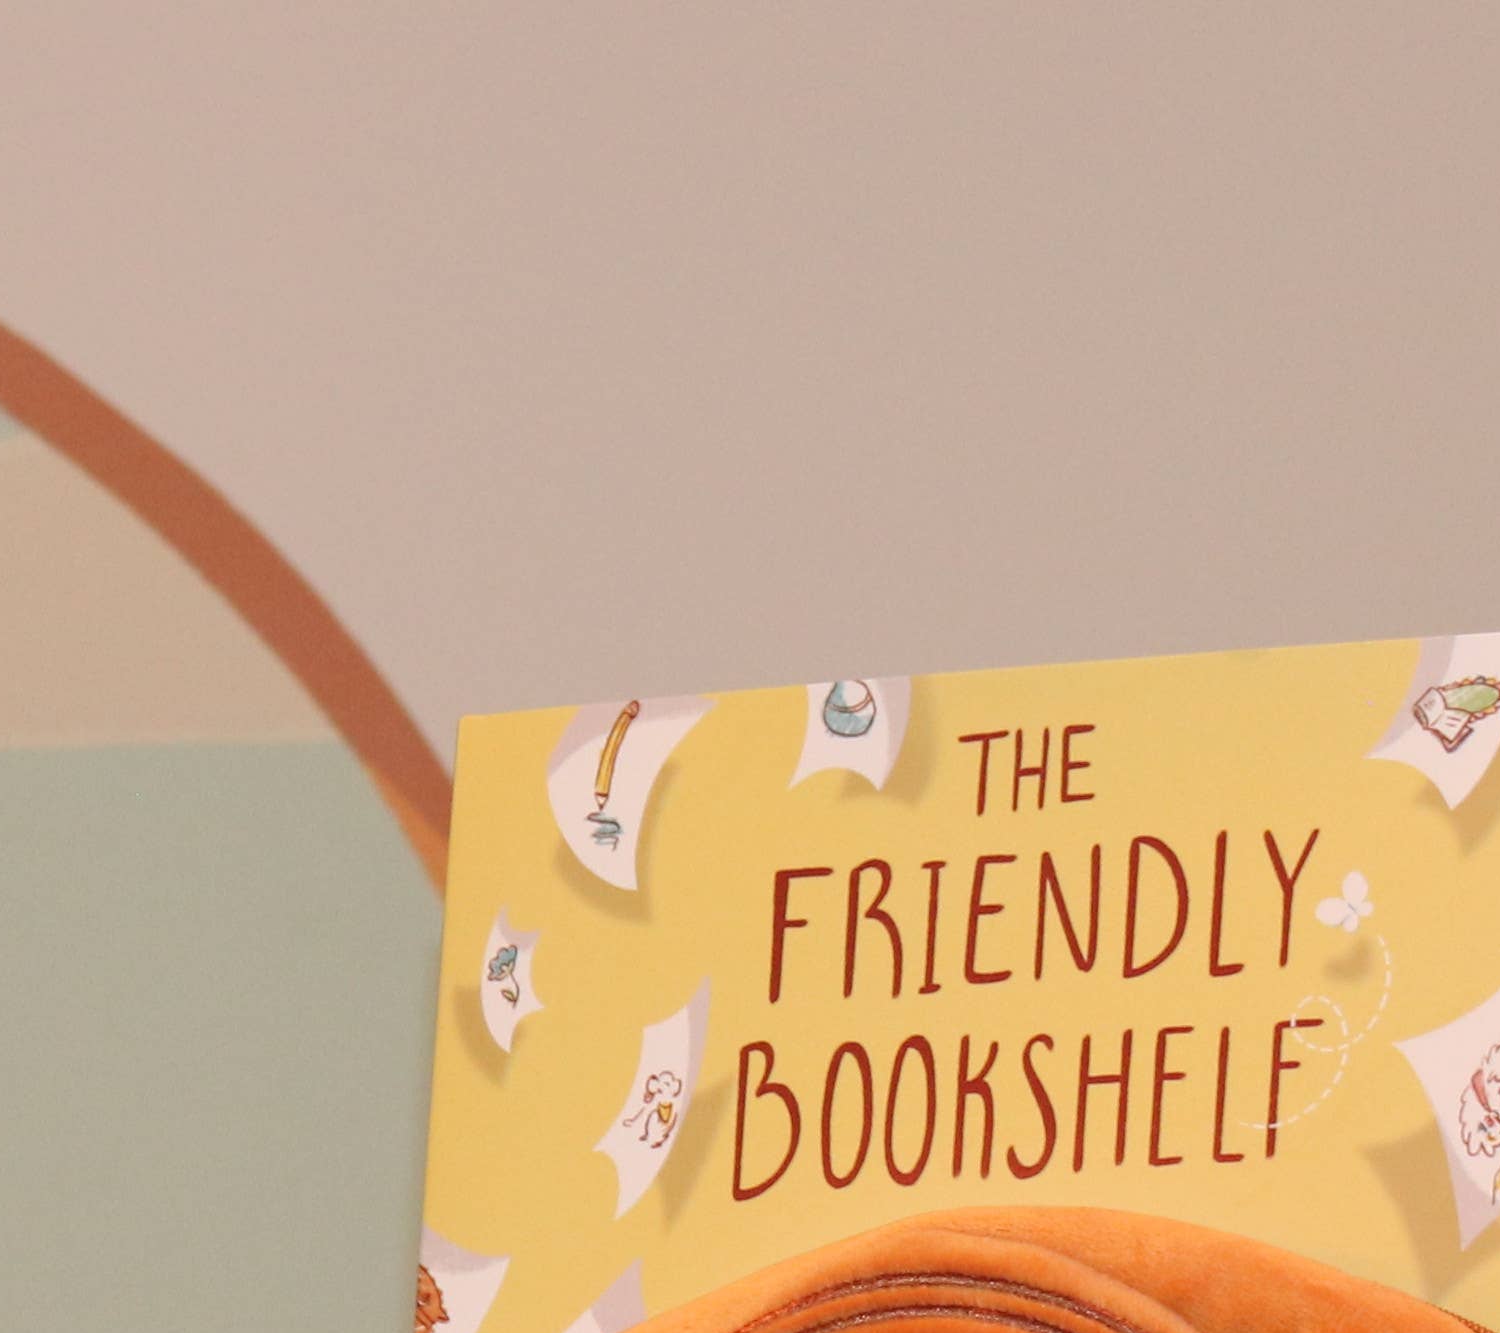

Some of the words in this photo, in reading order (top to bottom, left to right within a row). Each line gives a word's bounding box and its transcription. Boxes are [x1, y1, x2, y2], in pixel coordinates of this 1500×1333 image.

[956, 723, 1097, 818] THE
[767, 827, 1322, 1005] FRIENDLY
[731, 1017, 1325, 1203] BOOKSHELF
